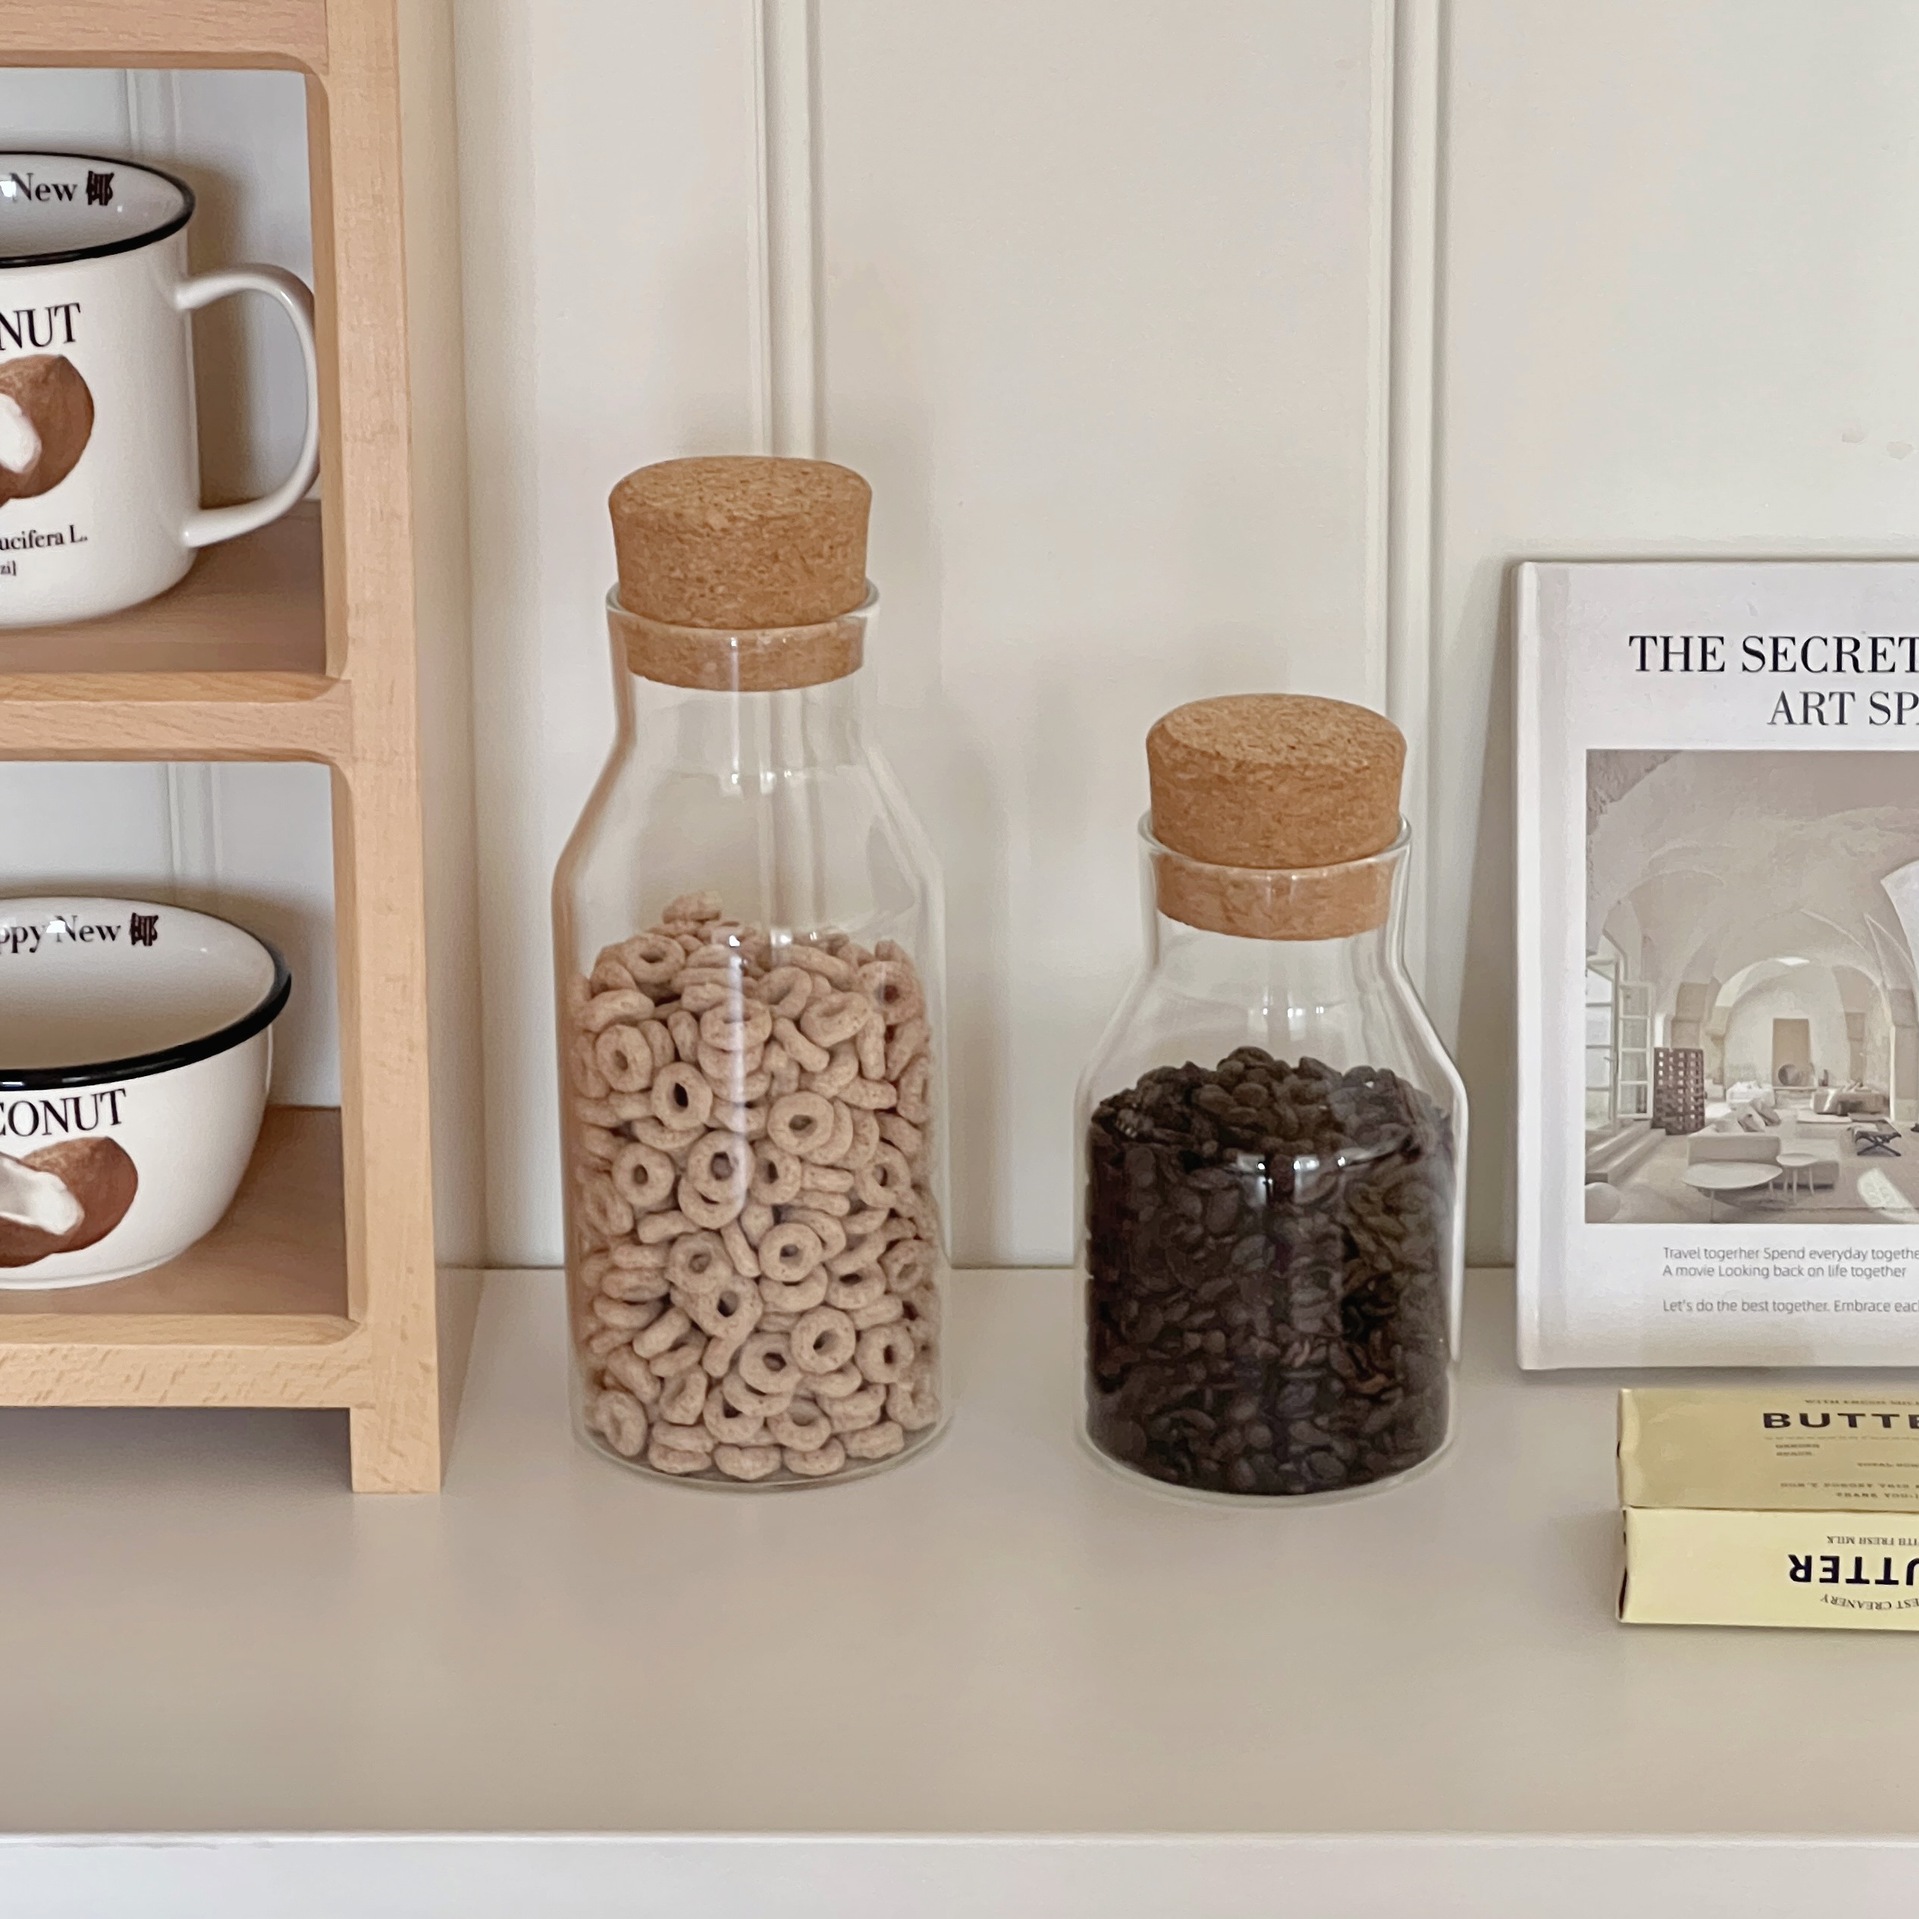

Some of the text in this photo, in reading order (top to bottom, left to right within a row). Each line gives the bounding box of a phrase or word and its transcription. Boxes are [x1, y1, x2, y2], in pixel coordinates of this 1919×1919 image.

[9, 170, 79, 204] New
[0, 528, 65, 551] ucifera
[1628, 635, 1919, 674] THE SECRET
[1766, 690, 1919, 726] ART SP
[54, 914, 121, 943] New
[0, 1087, 127, 1137] ONUT
[1663, 1246, 1702, 1260] Travel
[1763, 1246, 1806, 1262] Spend
[1808, 1246, 1868, 1262] everyday
[1662, 1264, 1907, 1280] A movie Looking back on life together
[1662, 1298, 1919, 1314] Let's do the best together. Embrace eac
[1826, 1535, 1919, 1546] ITH FRESH MILK
[1788, 1554, 1919, 1586] UTTER
